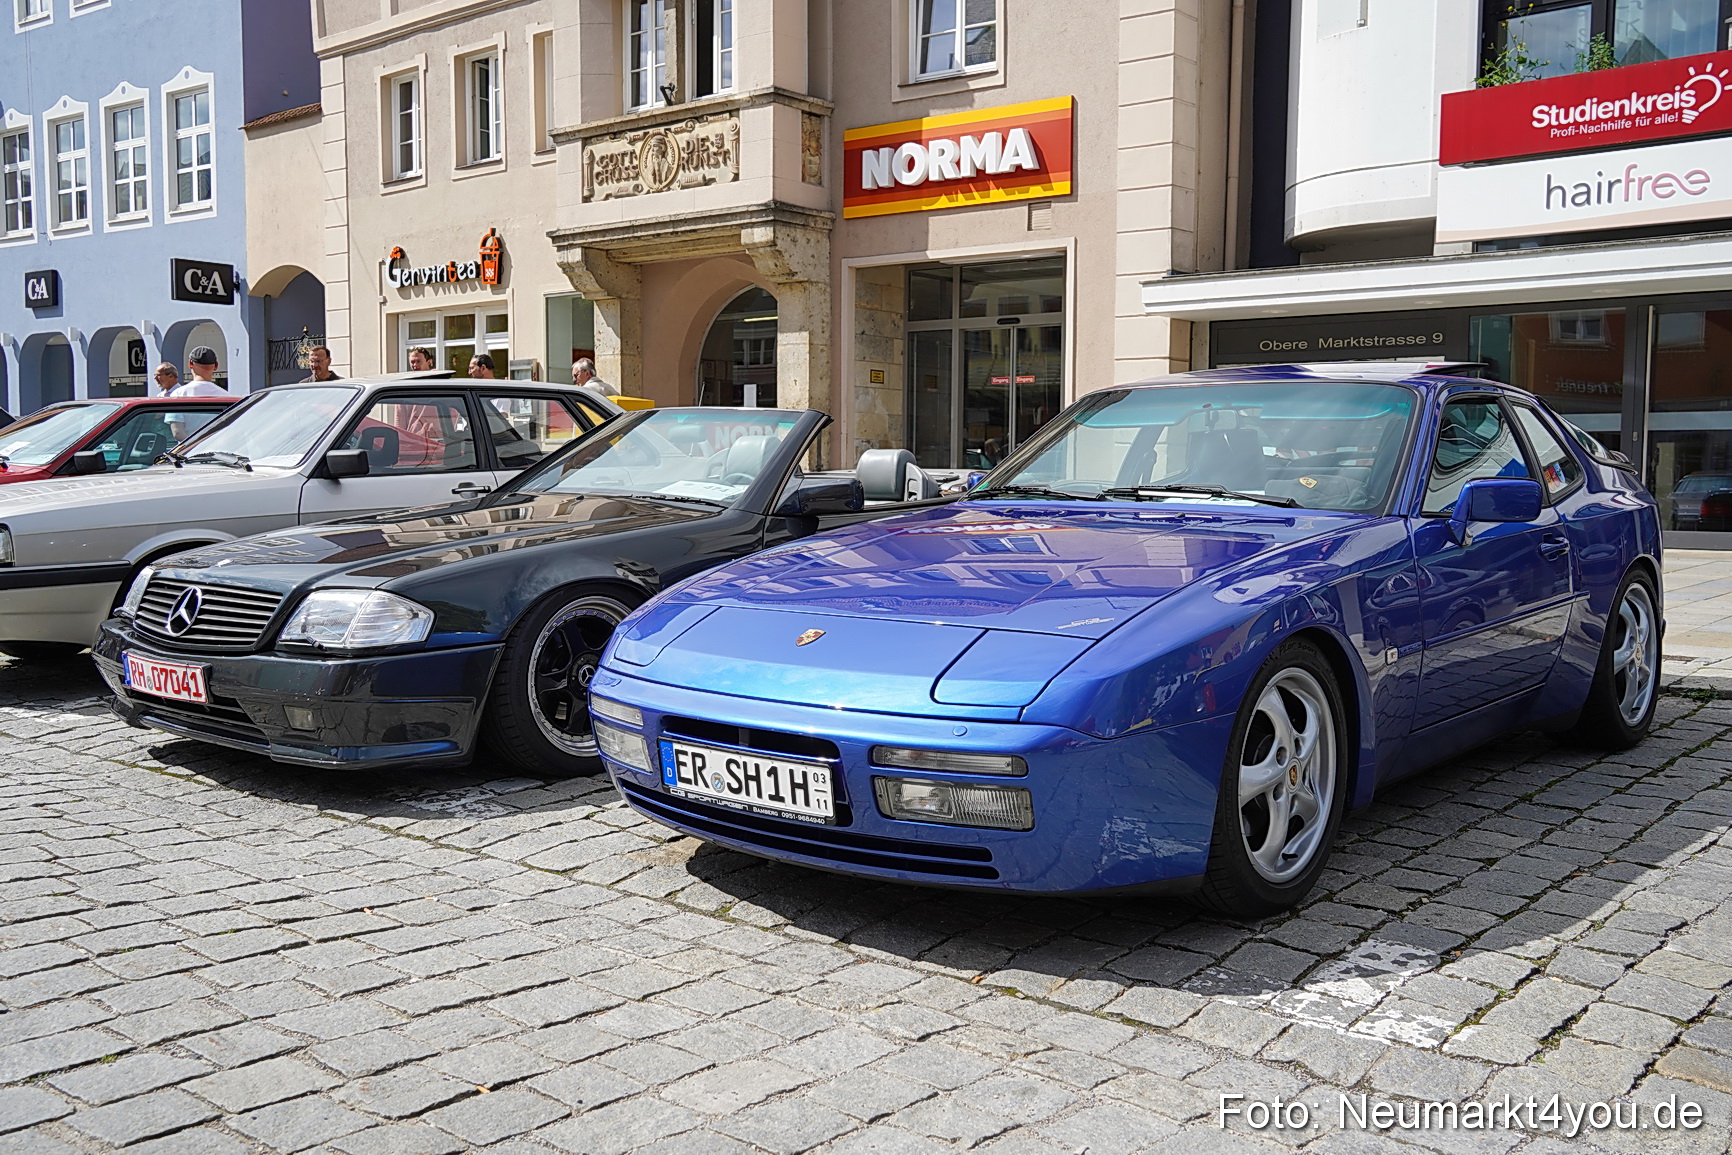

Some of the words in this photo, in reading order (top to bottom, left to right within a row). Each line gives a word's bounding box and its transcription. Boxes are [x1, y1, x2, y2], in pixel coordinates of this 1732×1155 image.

[1531, 85, 1697, 128] Studienkreis
[1550, 118, 1632, 138] Profi-Nachhilfe
[1635, 115, 1653, 128] für
[1654, 112, 1679, 125] alle!
[861, 127, 1040, 191] NORMA
[1545, 163, 1711, 210] hairfree
[183, 268, 228, 297] C&A
[385, 248, 478, 289] Gervintea
[27, 277, 49, 301] C&A
[1259, 340, 1309, 351] Obere
[1318, 335, 1427, 348] Marktstrasse
[1432, 332, 1444, 344] 9
[130, 660, 147, 688] RH
[151, 665, 203, 697] 07041
[666, 767, 673, 777] D
[674, 748, 710, 789] ER
[812, 772, 827, 784] 03
[815, 798, 829, 811] 11
